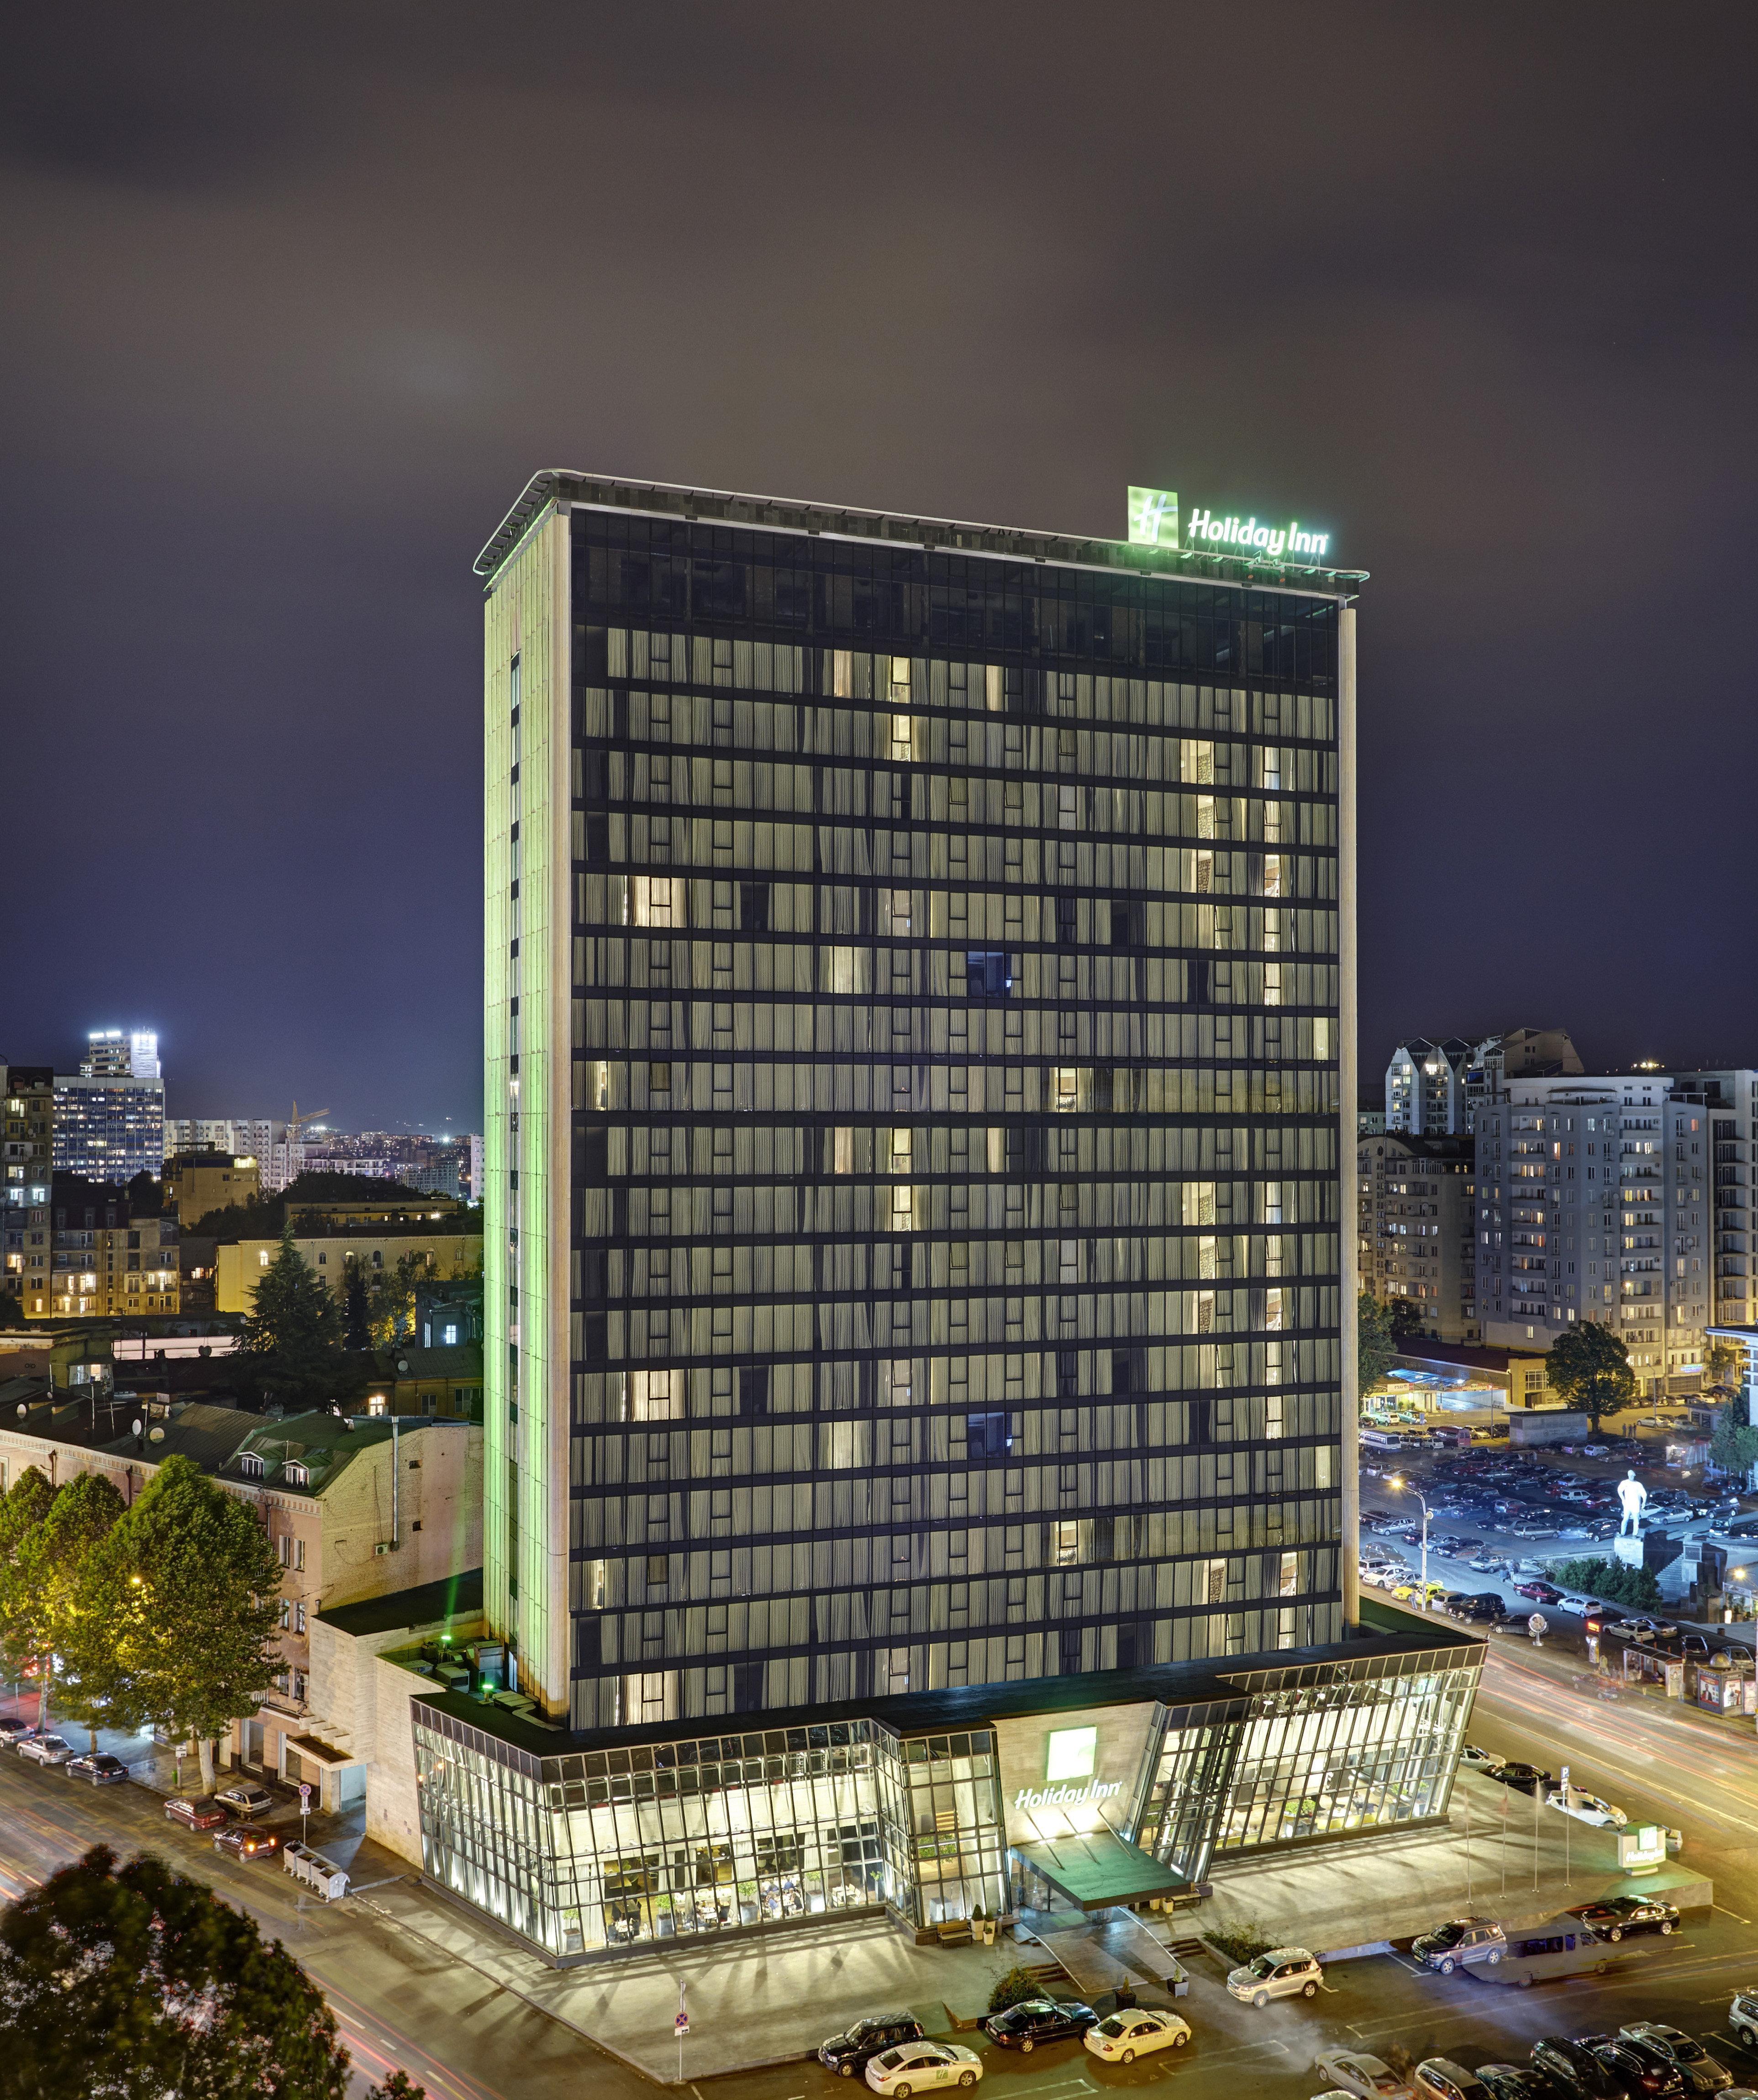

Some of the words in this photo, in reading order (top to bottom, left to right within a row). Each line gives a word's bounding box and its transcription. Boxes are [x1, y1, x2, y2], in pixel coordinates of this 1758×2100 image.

[1188, 508, 1285, 555] Holiday
[1288, 522, 1327, 554] Inn
[1563, 1768, 1569, 1777] P
[1015, 1784, 1089, 1810] Holiday
[1090, 1779, 1121, 1799] Inn
